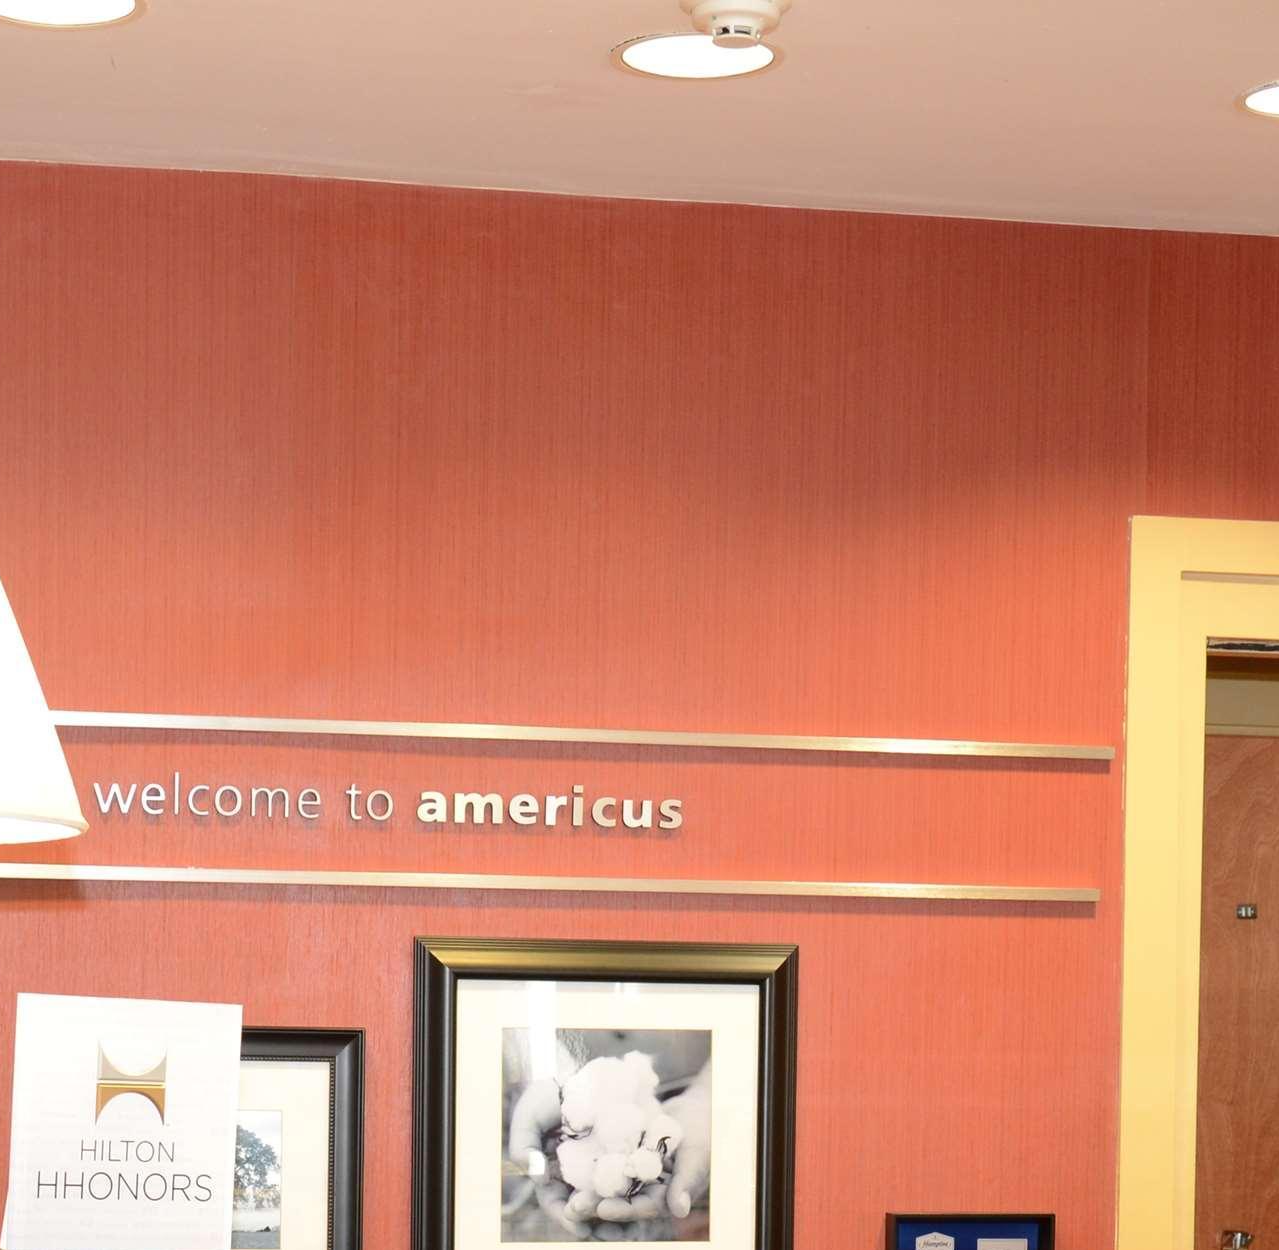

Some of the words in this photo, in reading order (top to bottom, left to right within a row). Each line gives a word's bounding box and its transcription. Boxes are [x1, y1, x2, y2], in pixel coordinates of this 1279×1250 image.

[93, 771, 321, 818] welcome
[345, 783, 394, 821] to
[417, 784, 684, 830] americus
[80, 1139, 175, 1163] HILTON
[36, 1170, 213, 1202] HHONORS
